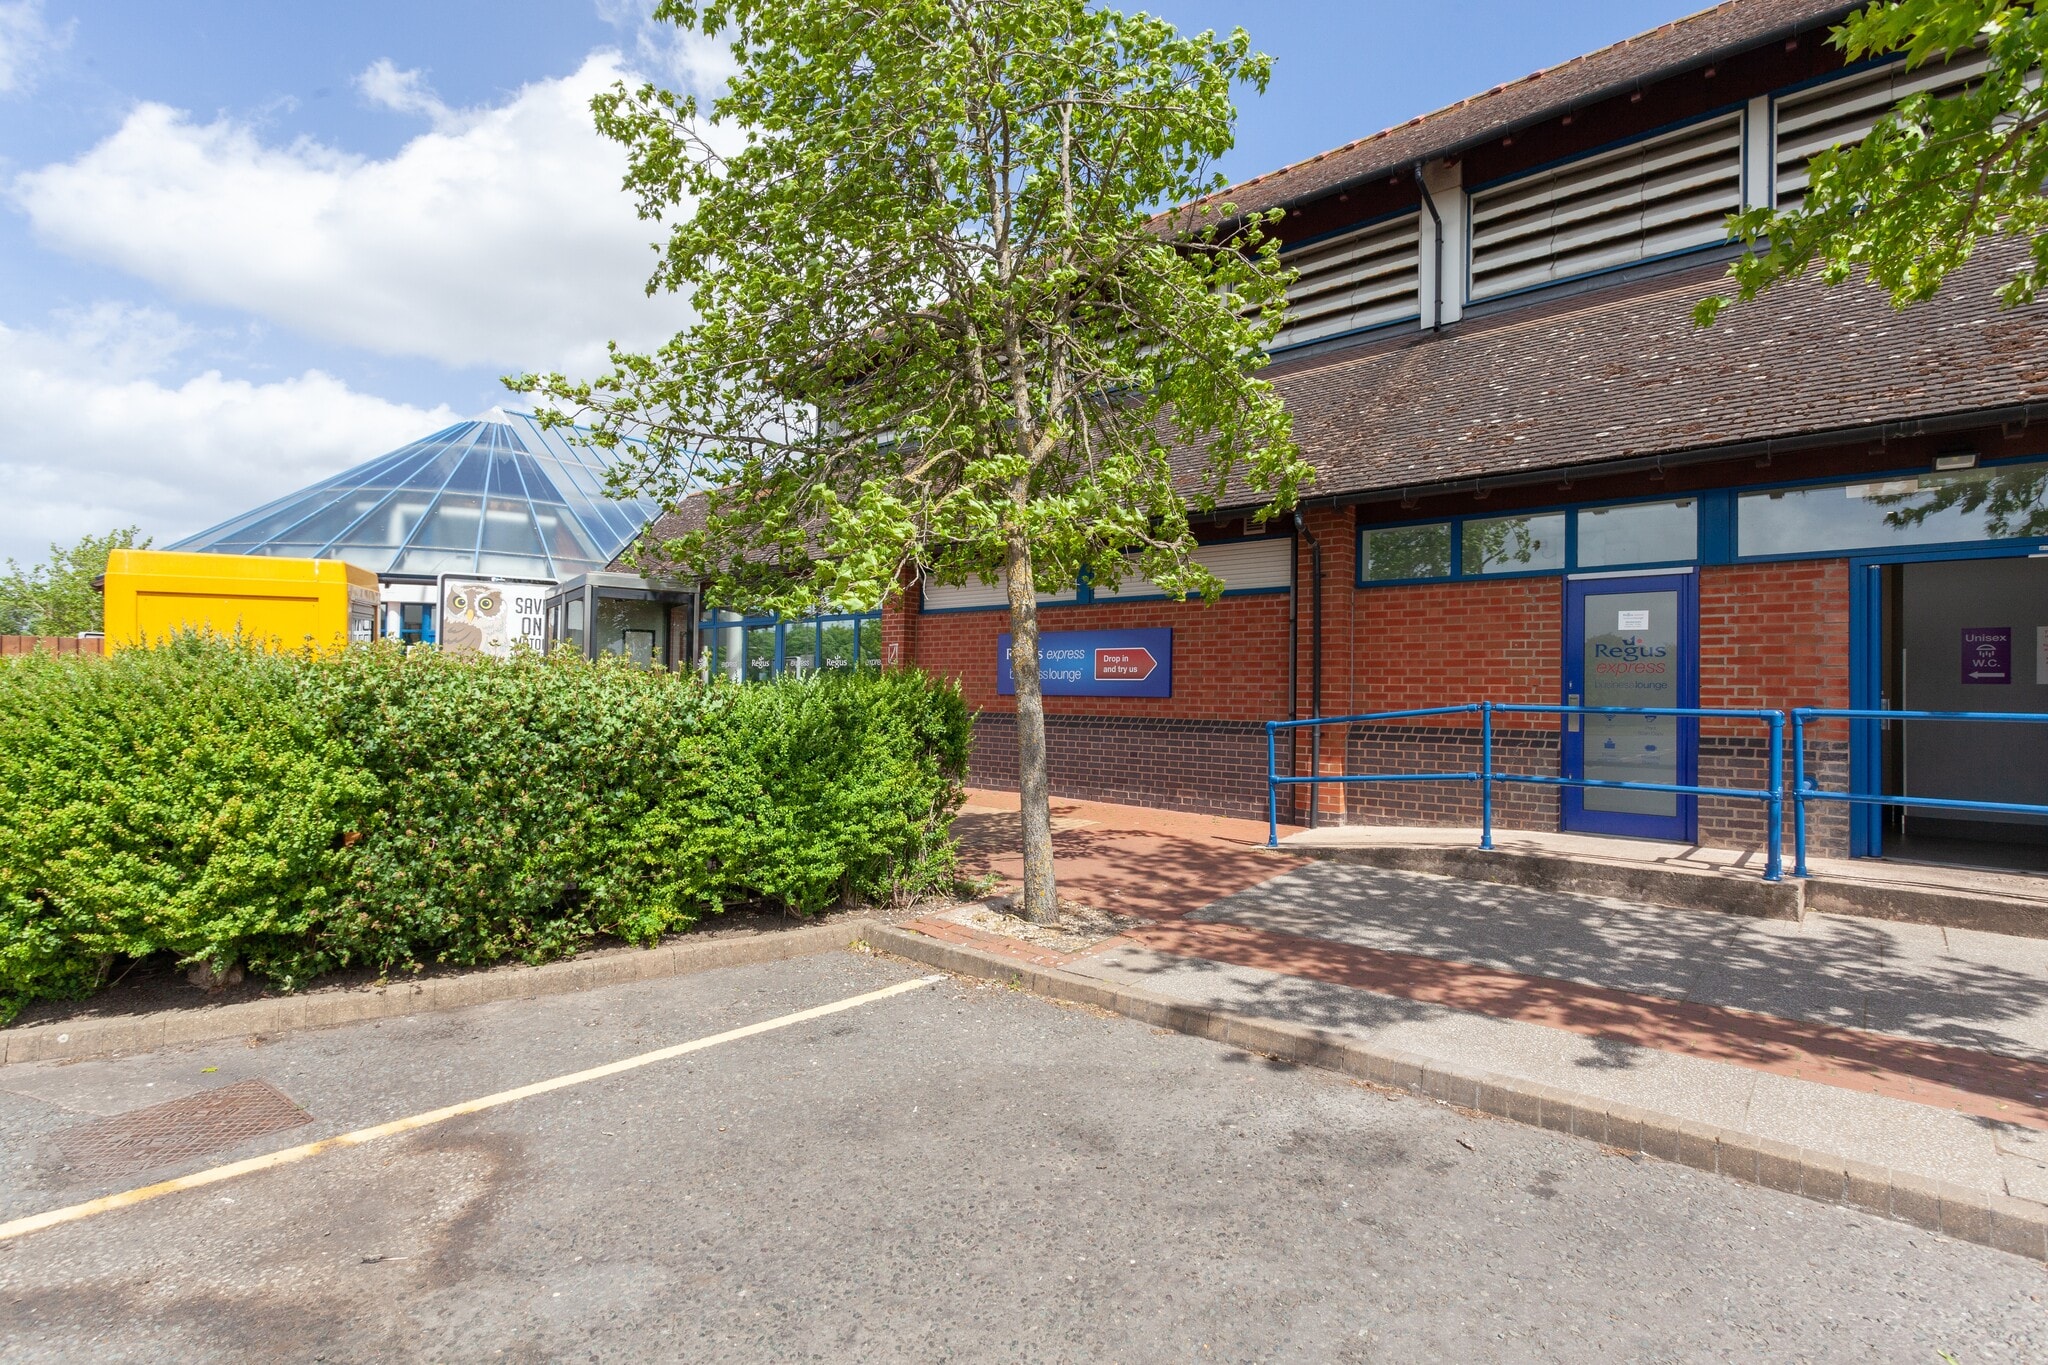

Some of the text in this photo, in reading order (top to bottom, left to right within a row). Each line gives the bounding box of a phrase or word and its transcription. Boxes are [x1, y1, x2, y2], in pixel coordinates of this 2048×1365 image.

[515, 597, 545, 615] SAV
[521, 617, 542, 636] ON
[1965, 633, 2007, 643] Unisex
[1046, 649, 1085, 662] express
[1594, 641, 1667, 662] Regus
[751, 656, 770, 669] Regus
[826, 655, 848, 669] Regus
[1103, 654, 1129, 664] Drop in
[1972, 659, 2001, 668] W.C.
[1103, 665, 1117, 673] and
[1117, 666, 1128, 675] try
[1596, 662, 1666, 677] express
